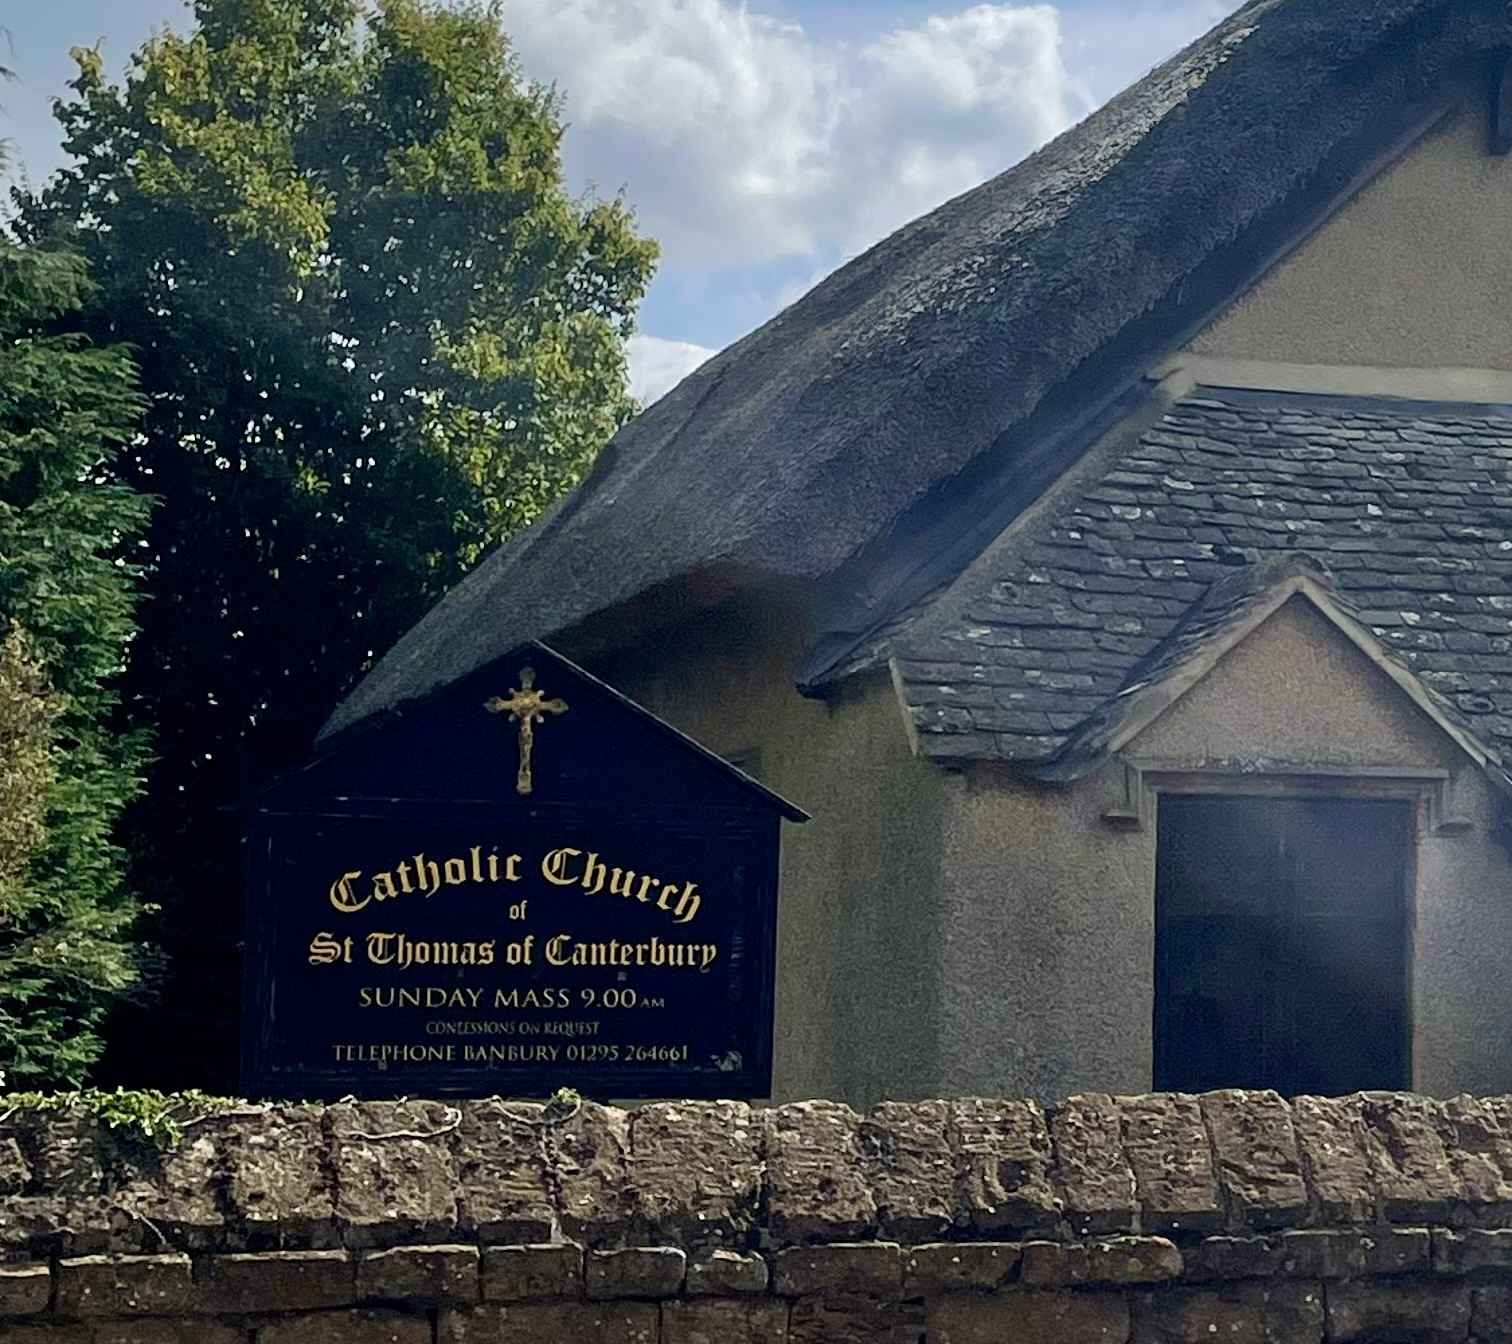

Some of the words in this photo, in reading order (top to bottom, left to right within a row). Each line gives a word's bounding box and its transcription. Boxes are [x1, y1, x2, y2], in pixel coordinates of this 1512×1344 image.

[329, 844, 523, 913] Catholic
[541, 847, 701, 924] Church
[508, 899, 528, 921] of
[308, 931, 354, 965] St
[366, 932, 496, 970] Thomas
[505, 934, 535, 967] of
[545, 933, 718, 973] Canterbury
[359, 987, 483, 1008] SUNDAY
[494, 988, 570, 1009] MASS
[580, 988, 637, 1008] 9.00
[544, 1021, 600, 1037] REQUEST
[332, 1044, 457, 1062] TELEPHONE
[463, 1044, 560, 1062] BANBURY
[566, 1044, 619, 1062] 01295
[624, 1044, 689, 1062] 264661
